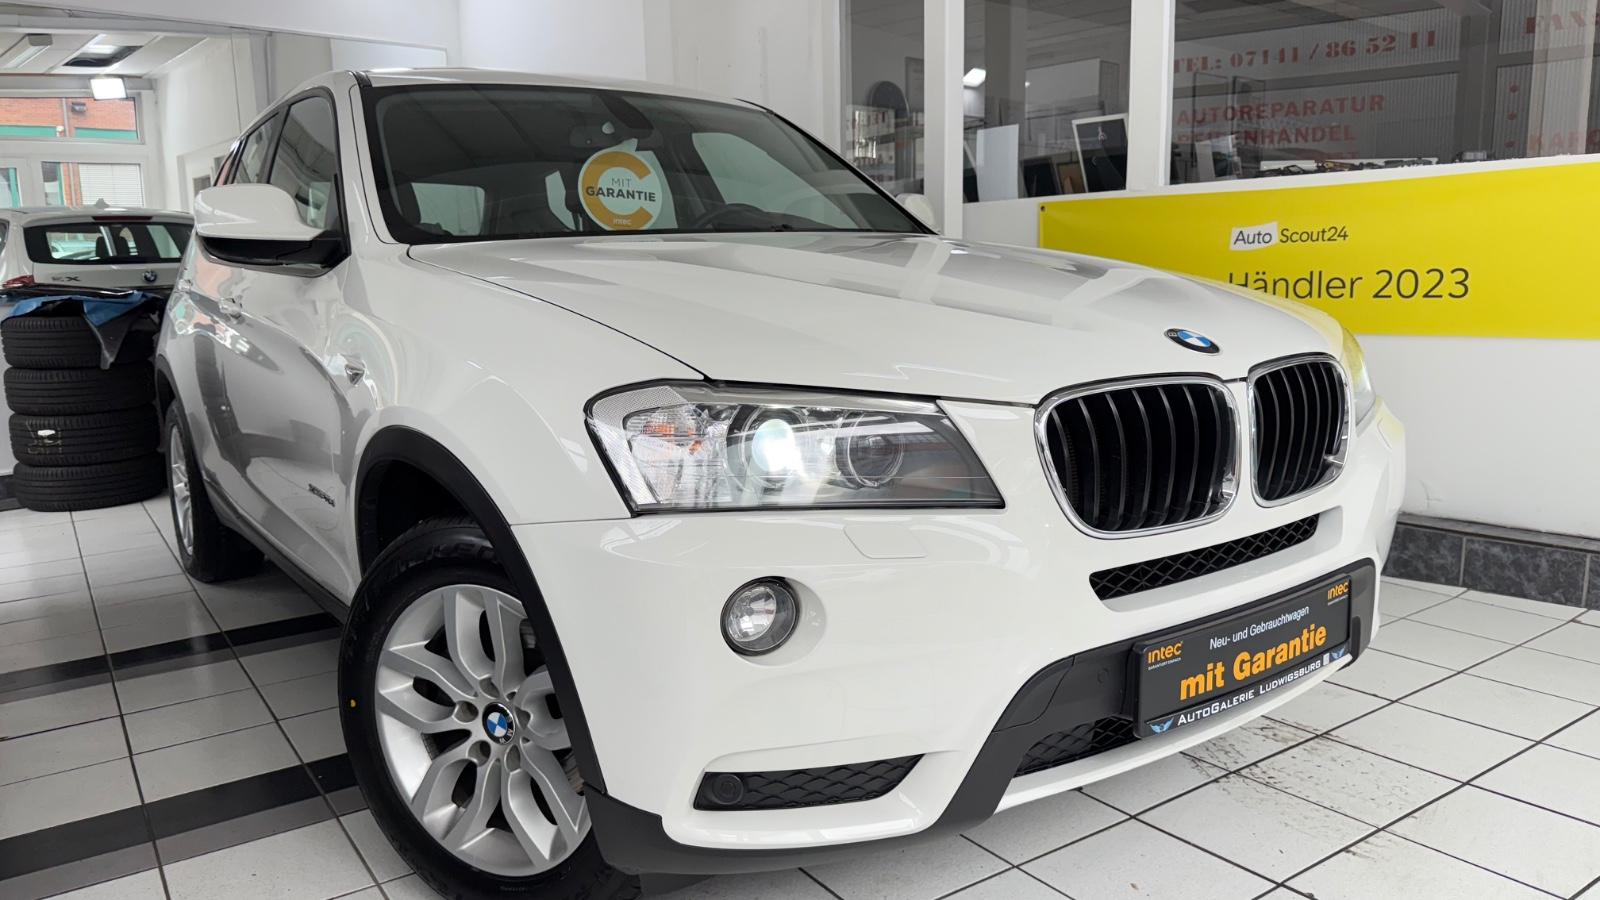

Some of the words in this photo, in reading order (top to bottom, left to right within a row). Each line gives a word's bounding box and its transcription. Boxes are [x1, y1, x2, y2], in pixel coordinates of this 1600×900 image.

[1325, 40, 1356, 58] 86
[1366, 34, 1396, 54] 52
[1411, 31, 1437, 49] 11
[1176, 94, 1385, 125] AUTOREPARATUR
[586, 186, 656, 202] GARANTIE
[611, 178, 632, 187] MIT
[1233, 230, 1273, 245] Auto
[1280, 225, 1349, 243] Scout24
[1229, 270, 1363, 299] Händler
[1372, 268, 1470, 299] 2023
[1327, 582, 1349, 601] intec
[1209, 637, 1231, 650] Neu-
[1232, 627, 1248, 642] und
[1249, 606, 1310, 637] Gebrauchtwagen
[1148, 642, 1183, 664] intec
[1180, 661, 1226, 700] mit
[1233, 623, 1327, 681] Garantie
[1259, 660, 1321, 694] LUDWIGSBURG
